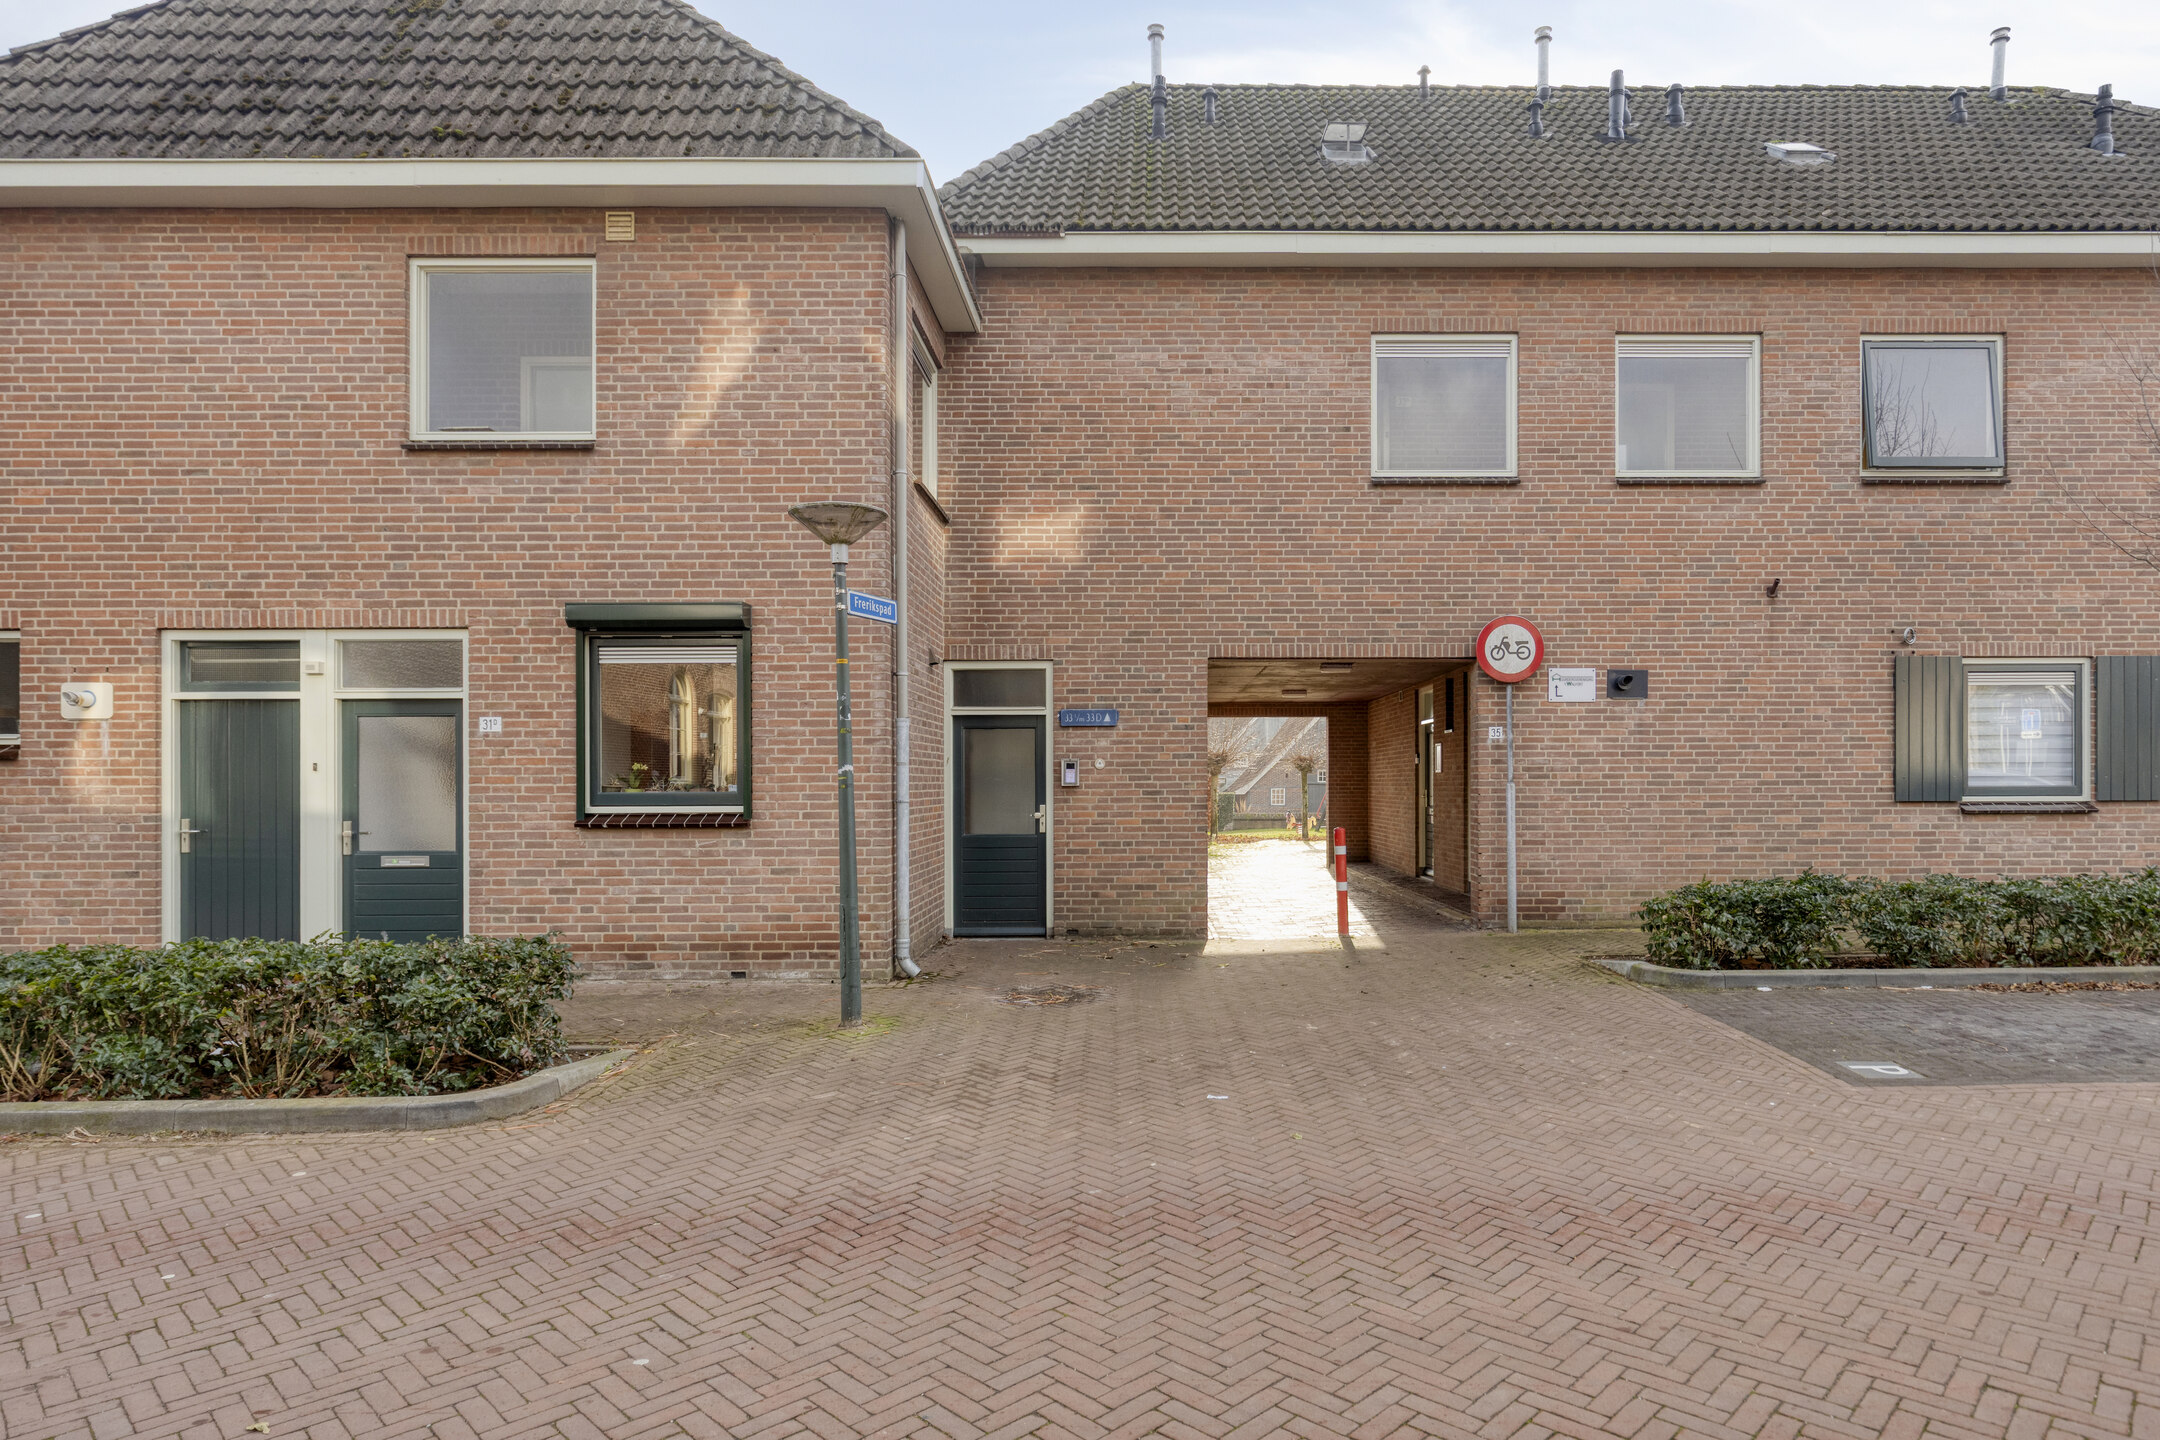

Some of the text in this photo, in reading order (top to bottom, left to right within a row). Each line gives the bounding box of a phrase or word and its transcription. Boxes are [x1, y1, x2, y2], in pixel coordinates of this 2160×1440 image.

[854, 596, 892, 616] Frerikspad
[1491, 728, 1501, 738] 35
[1848, 1065, 1909, 1075] P
